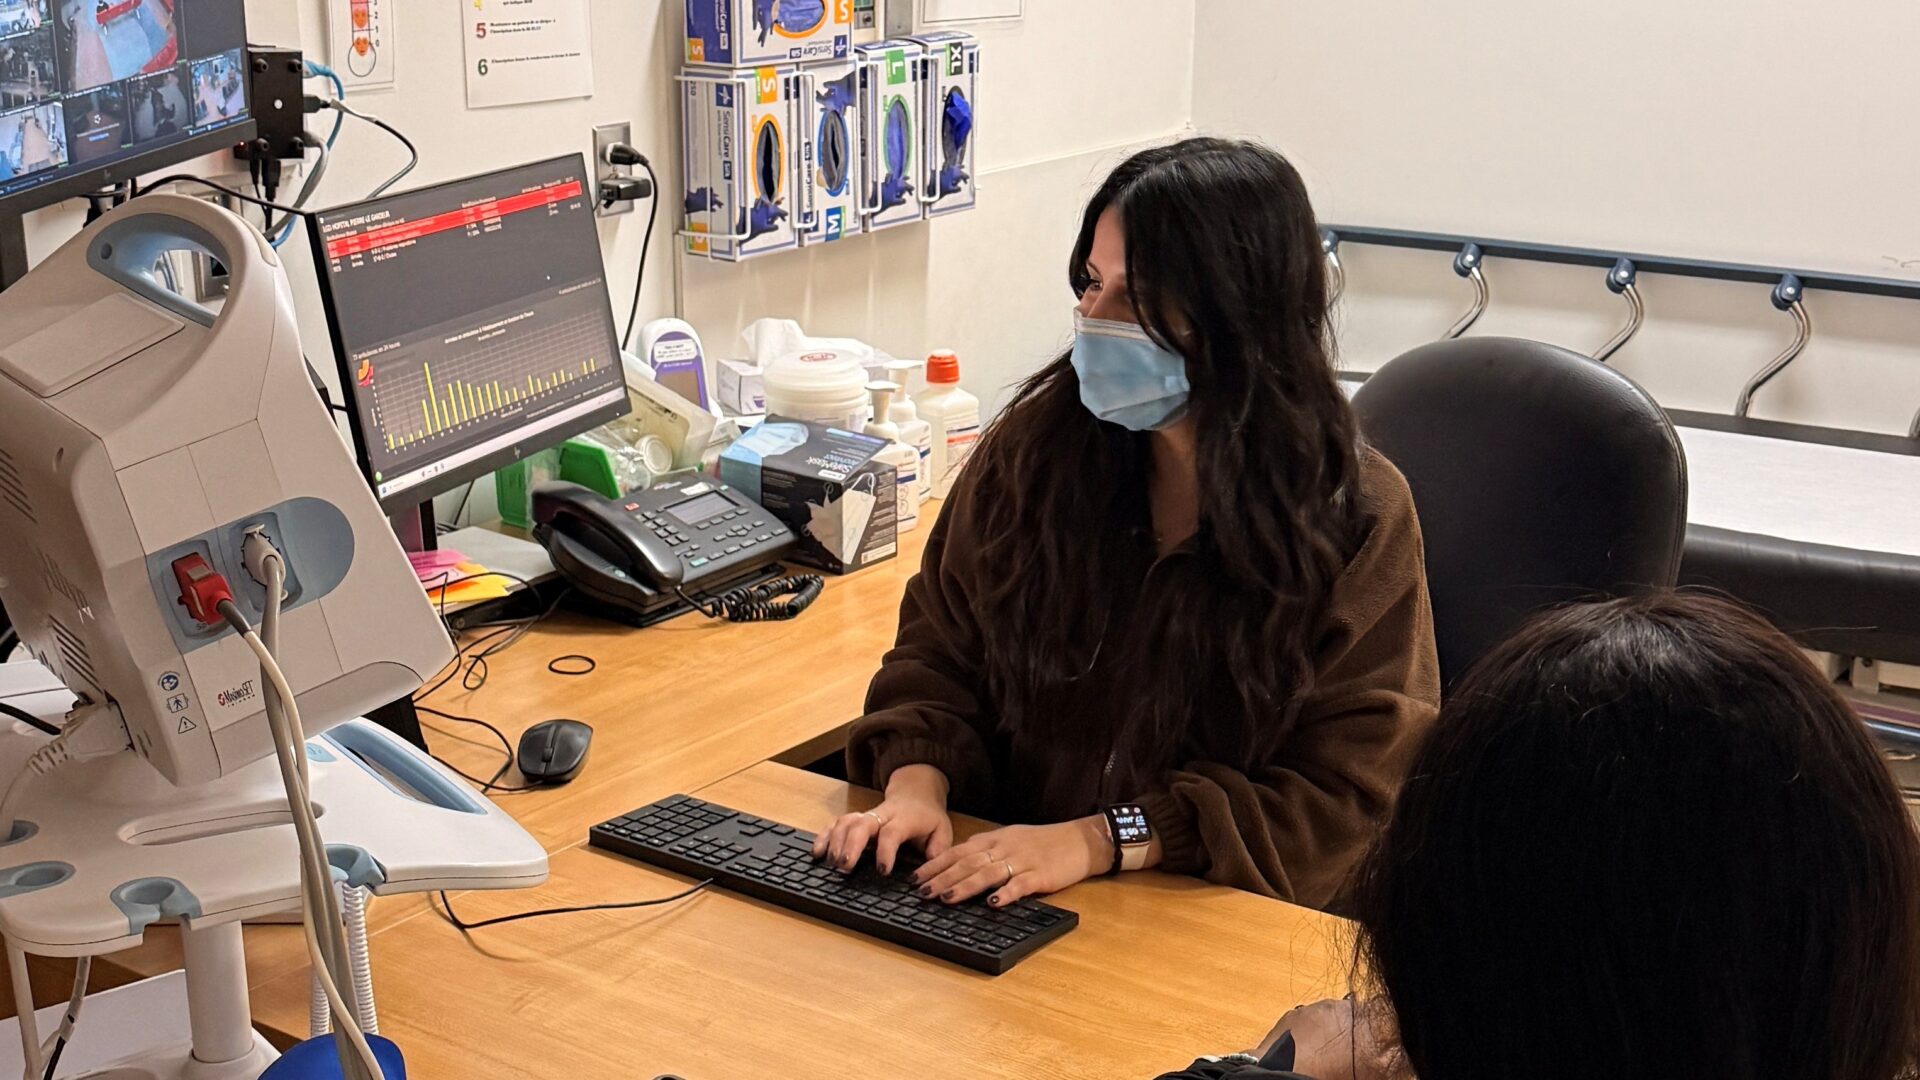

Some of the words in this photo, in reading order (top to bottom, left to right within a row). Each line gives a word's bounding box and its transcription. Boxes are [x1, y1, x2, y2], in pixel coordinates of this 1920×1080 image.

[374, 11, 379, 19] 2
[840, 0, 848, 20] S
[375, 25, 379, 33] 1
[476, 22, 487, 39] 5
[375, 39, 380, 47] 0
[692, 45, 703, 55] S
[803, 45, 832, 56] SensiCare
[478, 58, 488, 76] 6
[951, 46, 962, 73] XL
[892, 61, 903, 75] L
[762, 78, 776, 93] S
[723, 111, 731, 157] SensiCare
[828, 214, 840, 234] M
